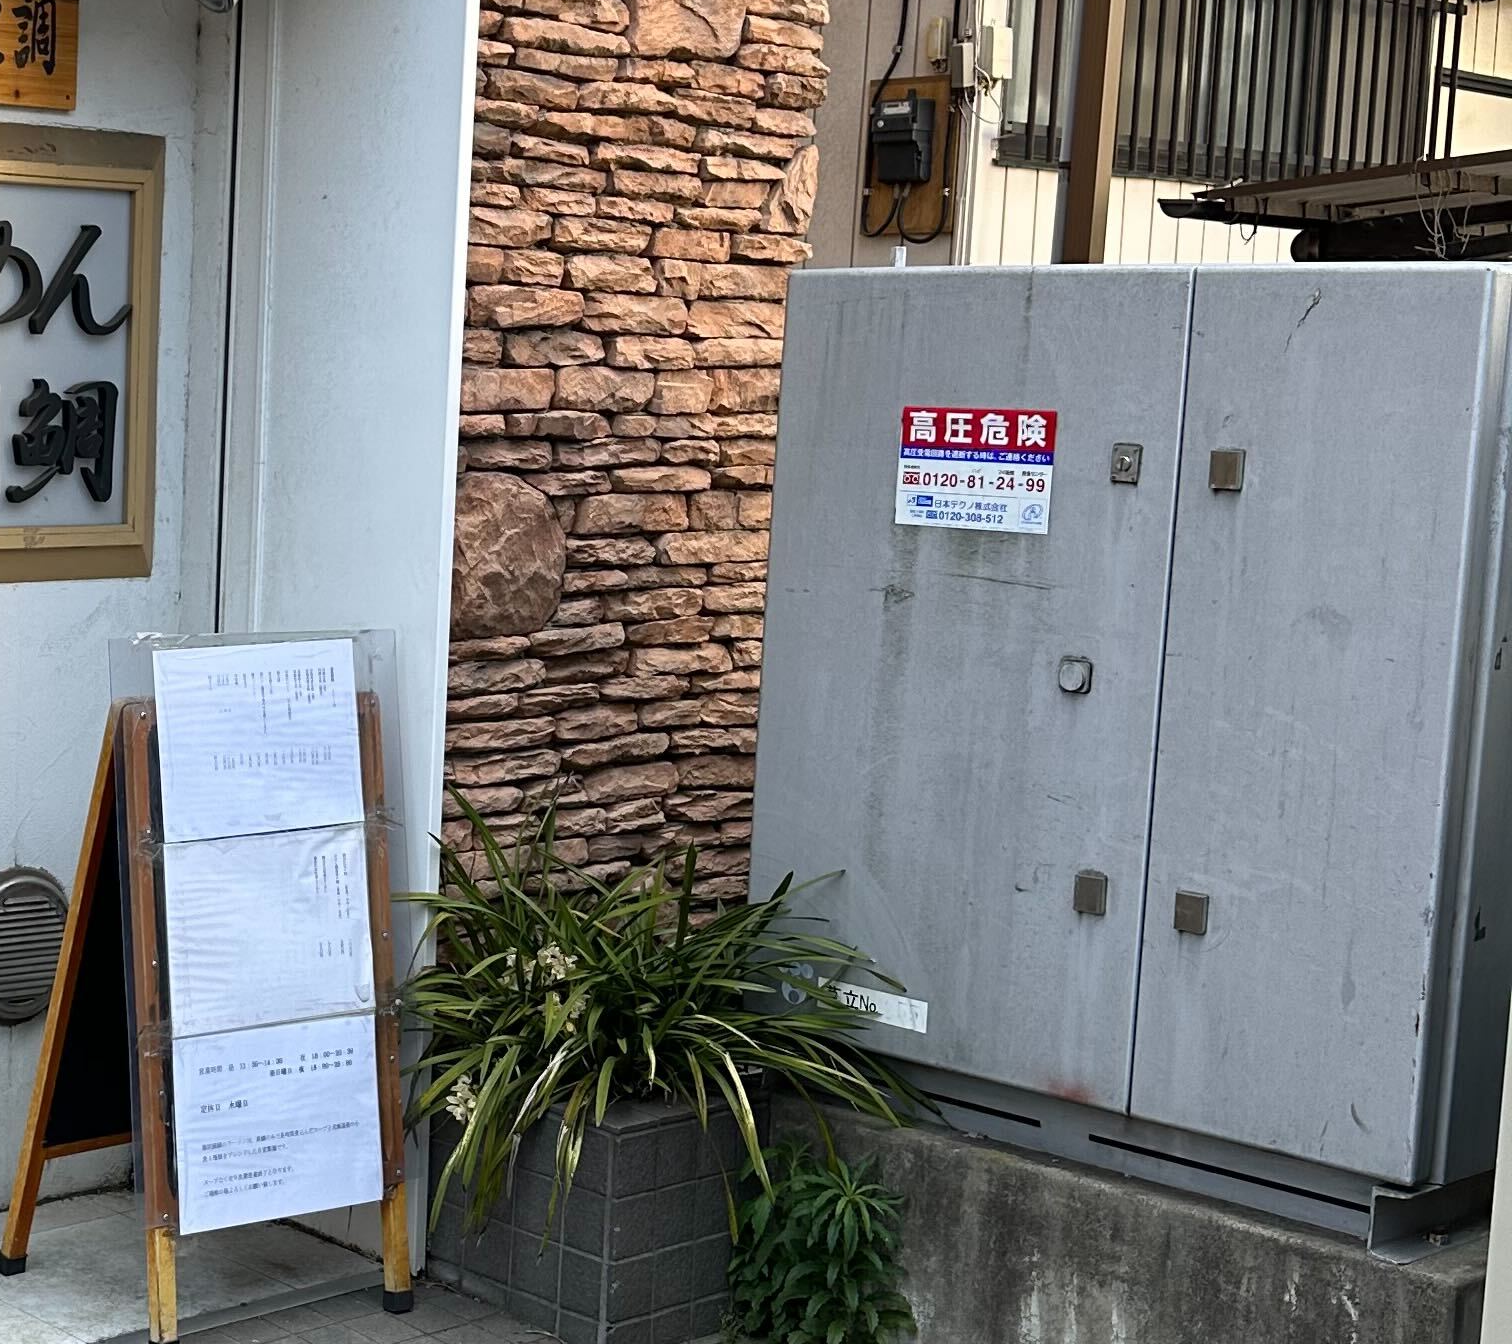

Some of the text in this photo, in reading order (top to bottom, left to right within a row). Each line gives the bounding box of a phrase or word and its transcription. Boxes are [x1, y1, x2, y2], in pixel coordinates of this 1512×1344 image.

[909, 410, 1048, 448] 高圧危険
[922, 472, 1046, 493] 0120-81-24-99
[934, 499, 1008, 513] 日本テクノ株式会社
